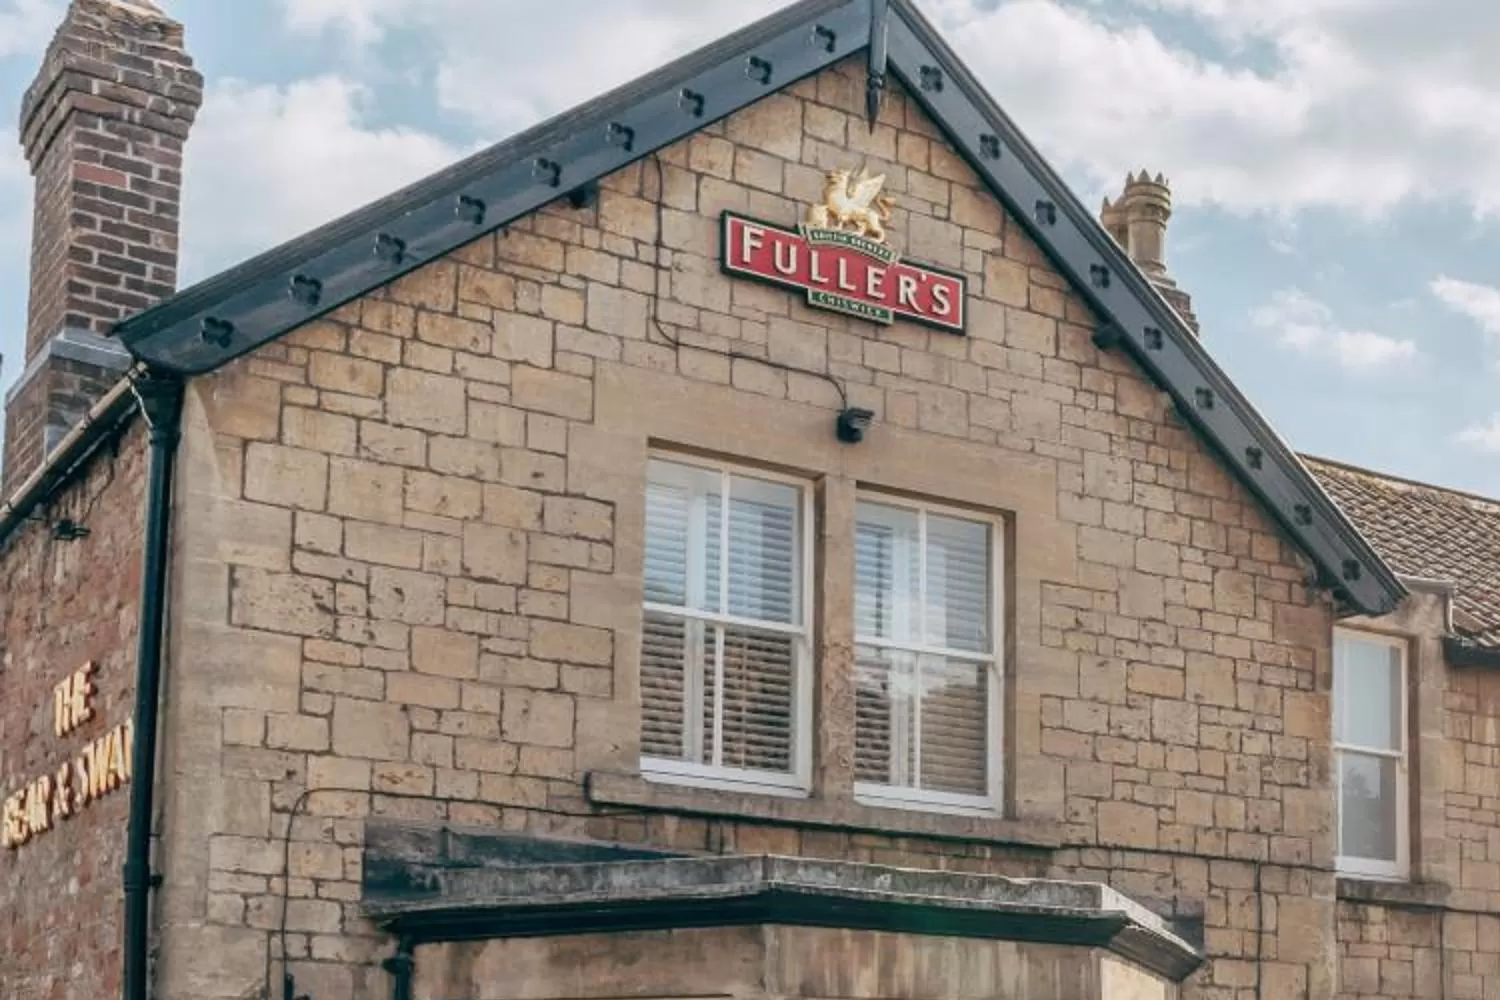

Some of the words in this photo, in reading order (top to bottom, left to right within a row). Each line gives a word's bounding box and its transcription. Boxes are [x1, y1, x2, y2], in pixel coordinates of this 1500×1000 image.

[742, 224, 951, 316] FULLER'S
[53, 660, 93, 738] THE
[53, 760, 71, 816] &
